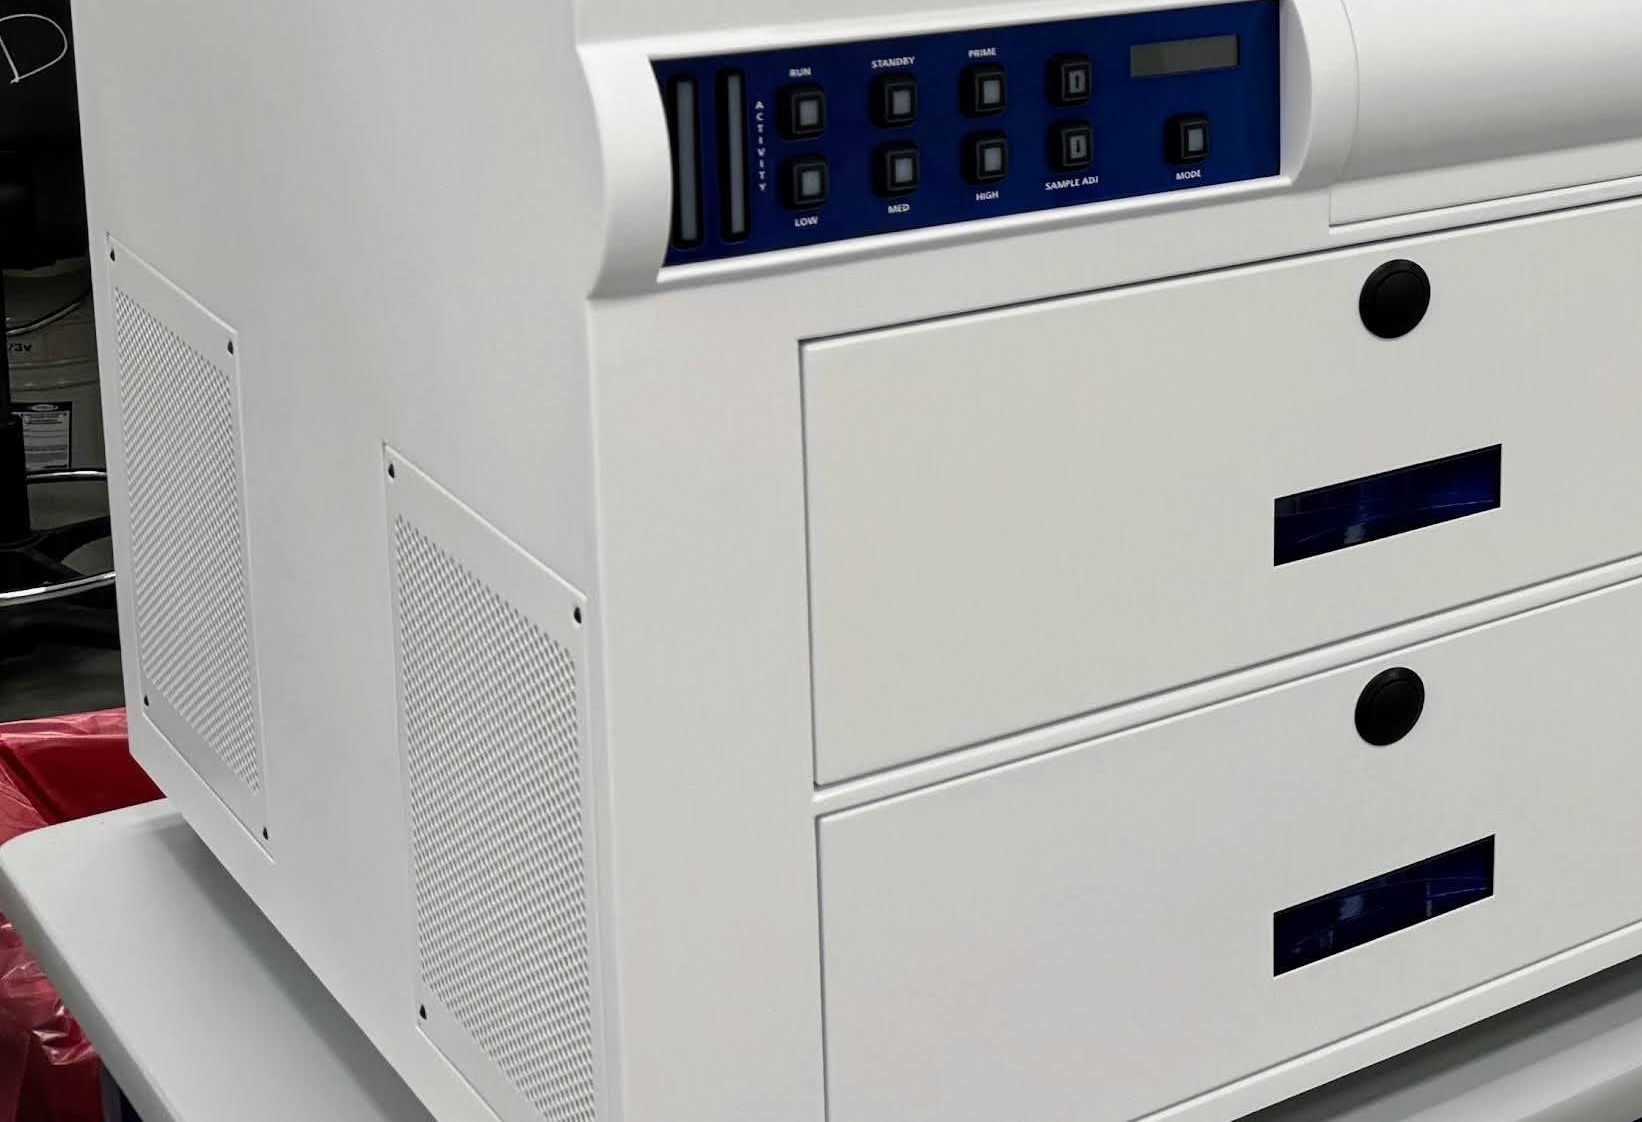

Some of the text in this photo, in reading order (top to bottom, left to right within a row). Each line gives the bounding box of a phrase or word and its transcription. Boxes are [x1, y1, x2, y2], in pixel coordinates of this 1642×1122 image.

[968, 47, 998, 59] PRIME
[871, 56, 916, 69] STANDBY
[789, 67, 812, 78] RUN
[1175, 169, 1202, 181] MODE
[1045, 176, 1099, 191] SAMPLE ADJ
[975, 190, 1000, 202] HIGH
[887, 203, 910, 215] MED
[794, 216, 819, 228] LOW
